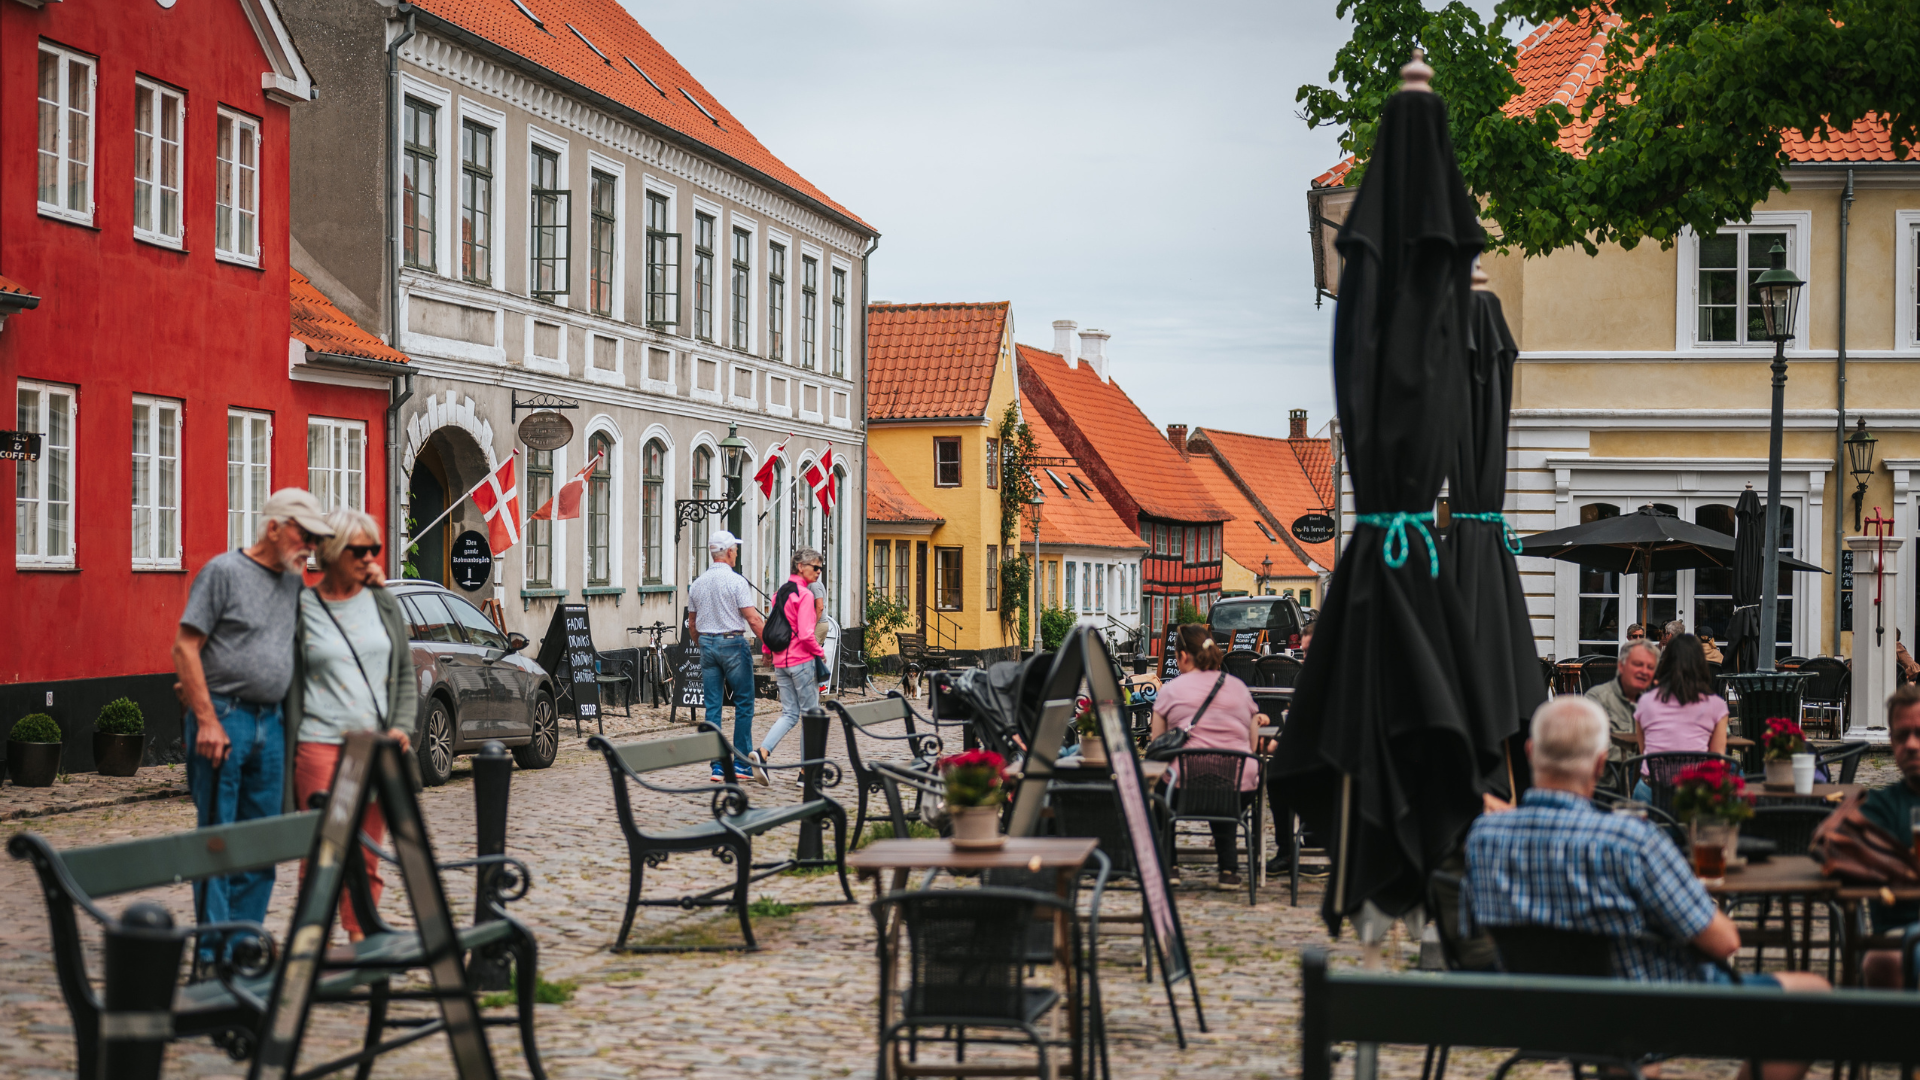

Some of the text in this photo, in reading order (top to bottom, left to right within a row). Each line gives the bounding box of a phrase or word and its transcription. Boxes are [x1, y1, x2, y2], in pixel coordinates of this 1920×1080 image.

[13, 442, 22, 451] &
[0, 450, 37, 461] COFFEE
[569, 635, 590, 648] DRINKS
[683, 694, 704, 705] CAF
[581, 704, 596, 715] SHOP
